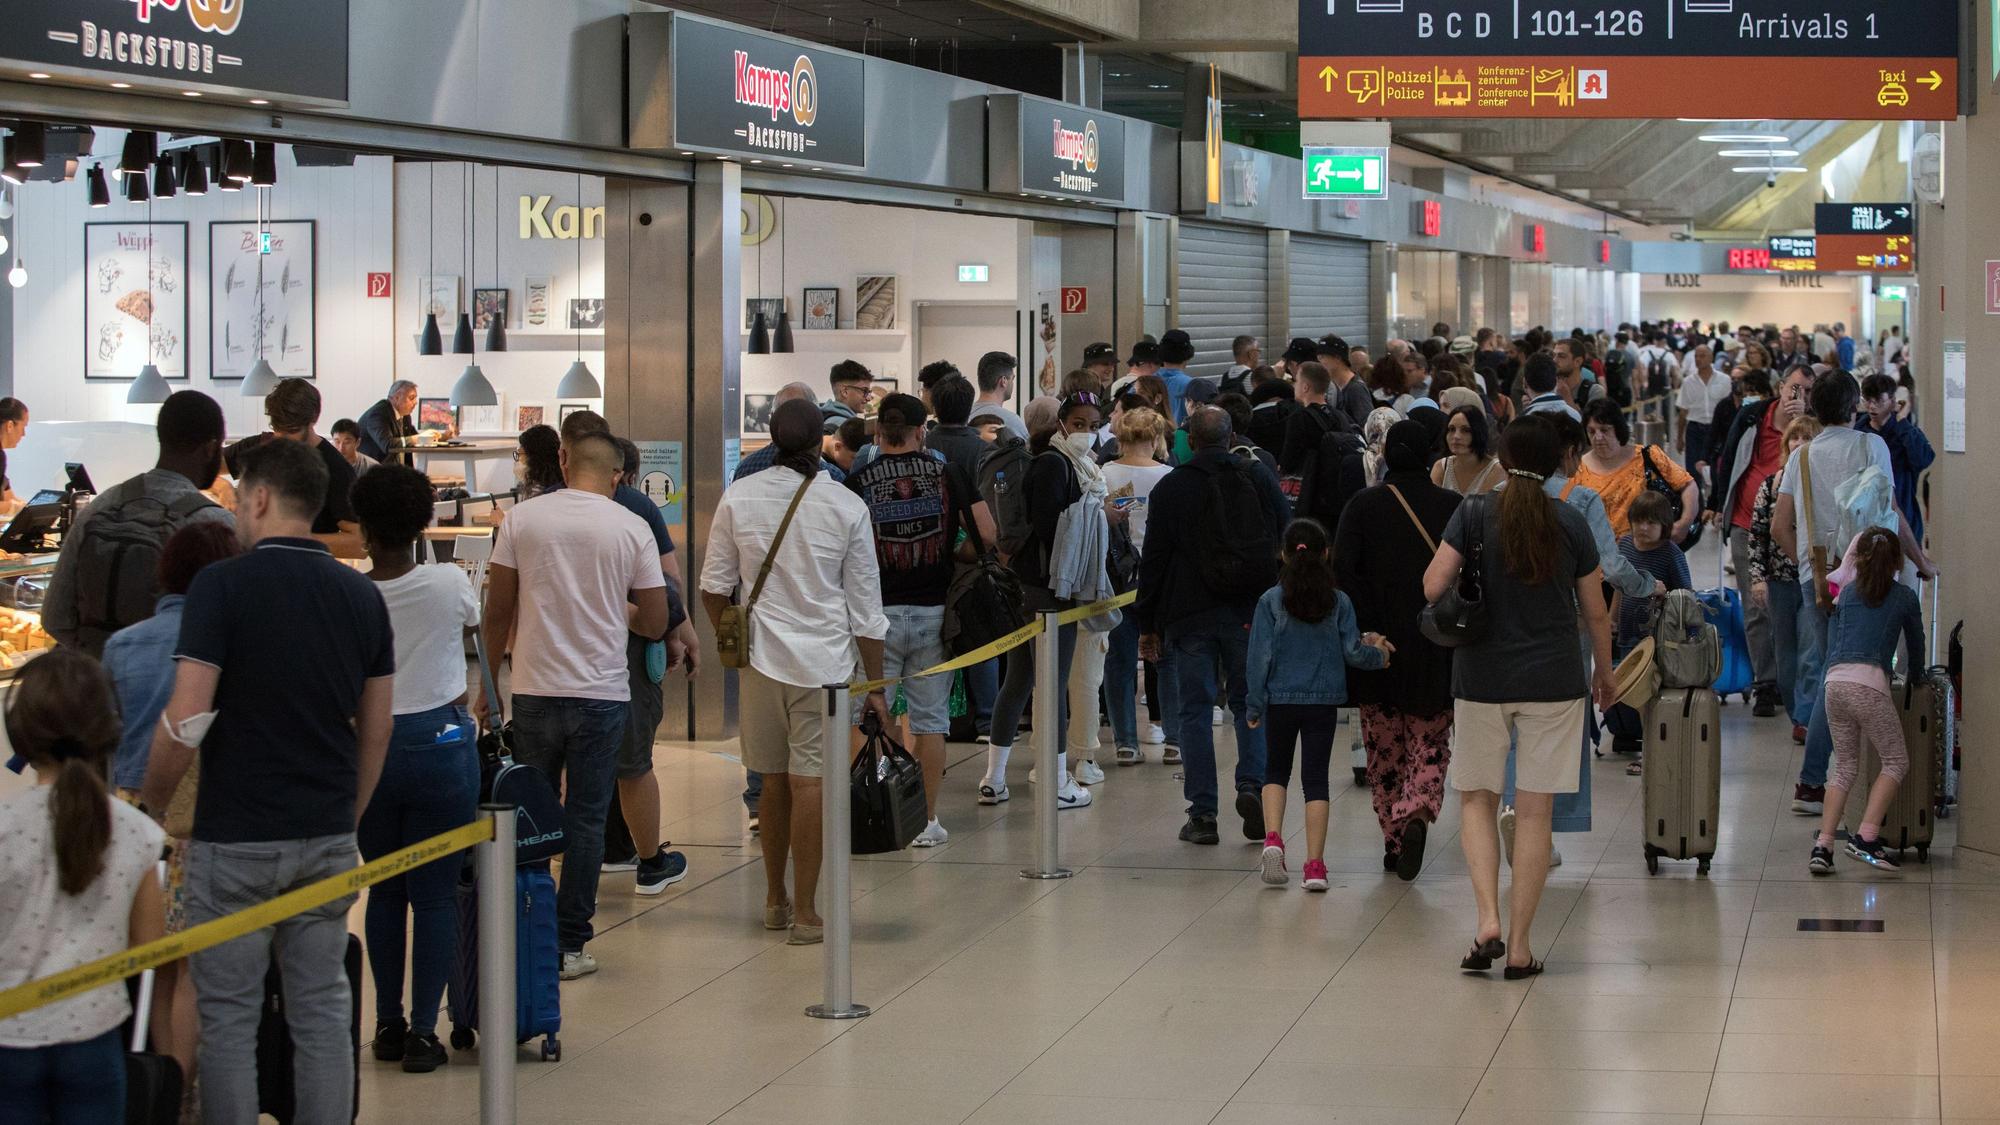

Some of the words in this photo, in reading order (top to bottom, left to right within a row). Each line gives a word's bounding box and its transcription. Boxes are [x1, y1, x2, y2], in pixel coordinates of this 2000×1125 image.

[1418, 12, 1434, 38] B
[1446, 12, 1463, 38] C
[1475, 12, 1491, 38] D
[1531, 10, 1644, 37] 101-126
[1739, 12, 1849, 39] Arrivals
[1865, 12, 1880, 39] 1
[1387, 71, 1433, 84] Polizei
[1478, 66, 1531, 77] Konferenz-
[1879, 70, 1907, 82] Taxi
[734, 50, 790, 121] Kamps
[1478, 76, 1518, 86] zentrum
[1387, 87, 1425, 100] Police
[1478, 88, 1529, 99] Conference
[1478, 98, 1509, 107] center
[1053, 119, 1084, 170] Kamps
